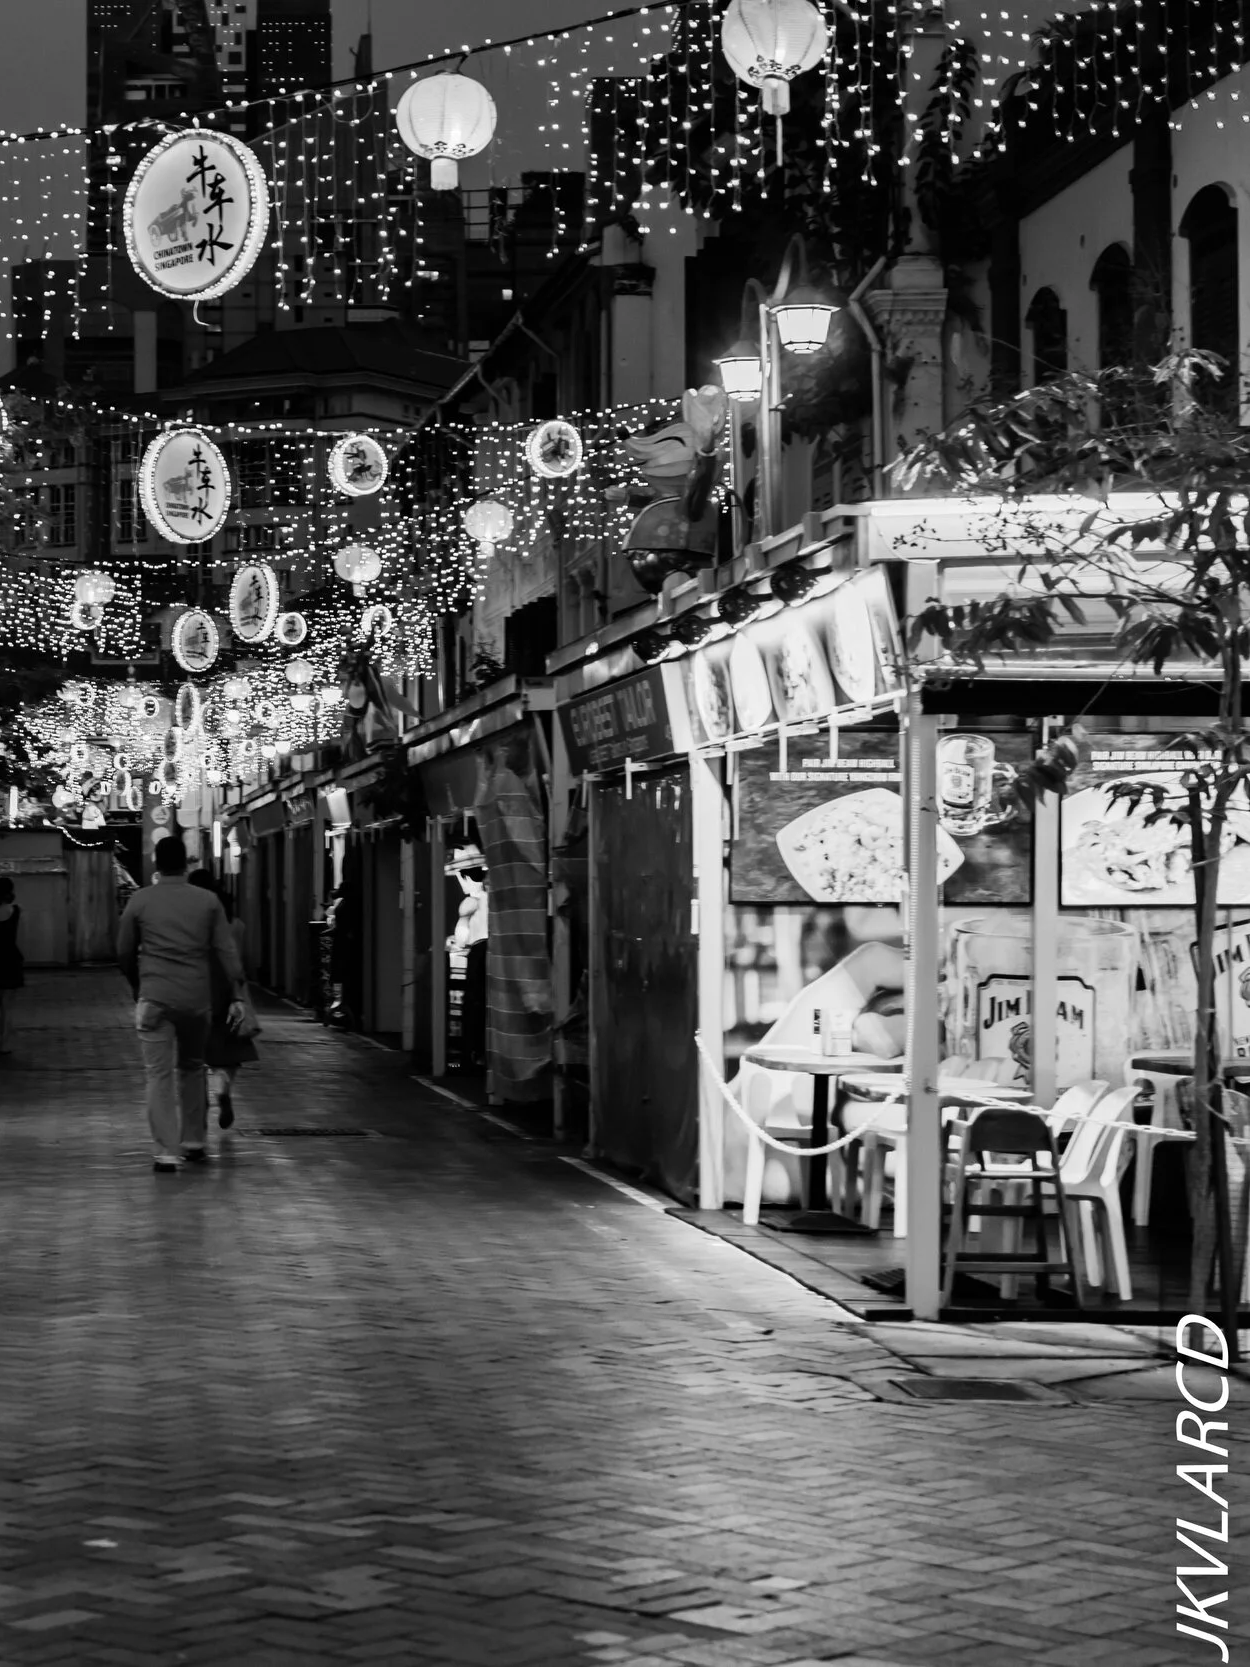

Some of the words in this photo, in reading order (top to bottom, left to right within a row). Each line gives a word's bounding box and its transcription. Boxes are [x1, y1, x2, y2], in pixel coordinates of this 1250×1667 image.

[153, 242, 193, 260] CHINATOWN
[155, 254, 193, 271] SINGAPORE
[983, 996, 1022, 1029] JIM
